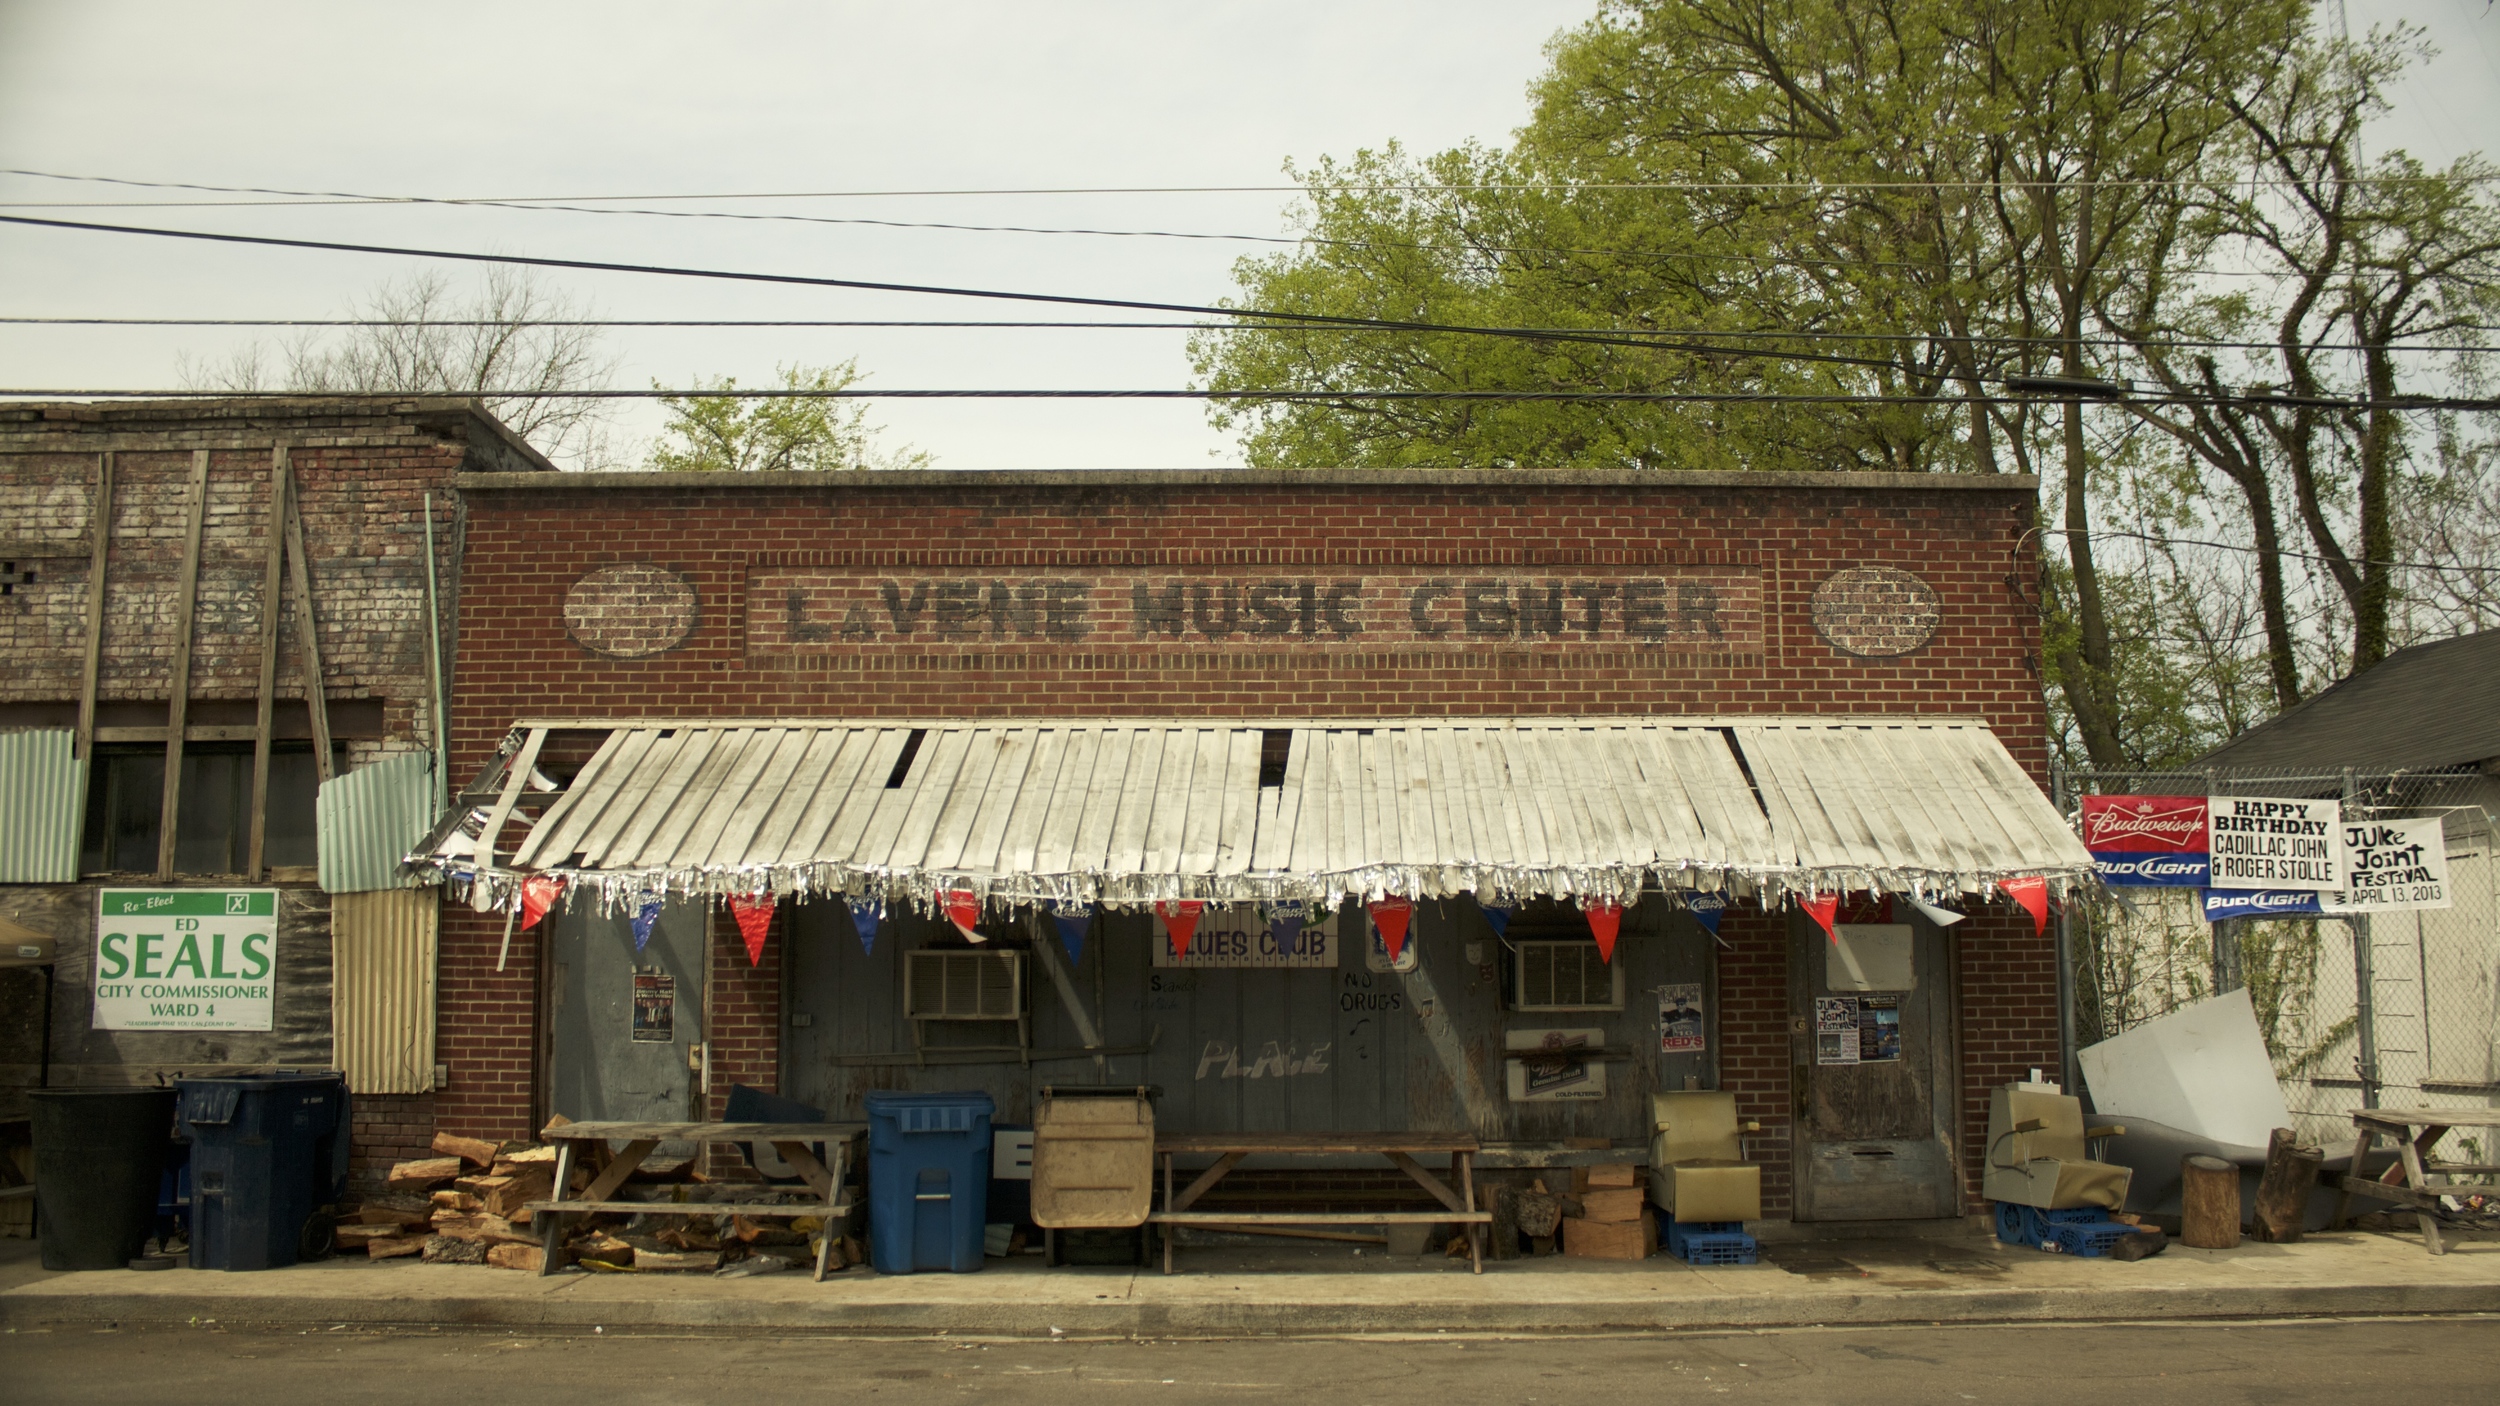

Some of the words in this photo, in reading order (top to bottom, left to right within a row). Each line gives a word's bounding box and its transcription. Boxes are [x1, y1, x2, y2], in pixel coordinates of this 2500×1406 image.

[1131, 579, 1364, 641] MUSIC
[1409, 578, 1724, 642] CENTER
[2233, 801, 2308, 819] HAPPY
[2088, 812, 2204, 833] Budweiser
[2214, 815, 2328, 836] BIRTHDAY
[2215, 834, 2286, 857] CADILLAC
[2291, 838, 2328, 859] JOHN
[2355, 844, 2425, 870] Joint
[2144, 862, 2207, 874] LIGHT
[2212, 856, 2221, 876] &
[2226, 857, 2275, 879] ROGER
[2279, 860, 2333, 881] STOLLE
[2350, 866, 2439, 888] FESTIVAL
[122, 894, 176, 914] Re-Elect
[2206, 896, 2250, 910] BUD
[2257, 893, 2315, 906] LIGHT
[2353, 888, 2389, 904] APRIL
[2412, 884, 2442, 901] 2013
[175, 918, 199, 931] ED
[100, 932, 271, 981] SEALS
[1344, 972, 1372, 988] NO
[97, 984, 134, 998] CITY
[140, 984, 269, 999] COMMISSIONER
[150, 1003, 199, 1017] WARD
[205, 1003, 216, 1017] 4
[1340, 993, 1400, 1012] DRUGS
[1662, 1035, 1704, 1048] RED'S
[1195, 1039, 1332, 1081] PLACE
[1562, 1068, 1581, 1079] Draft
